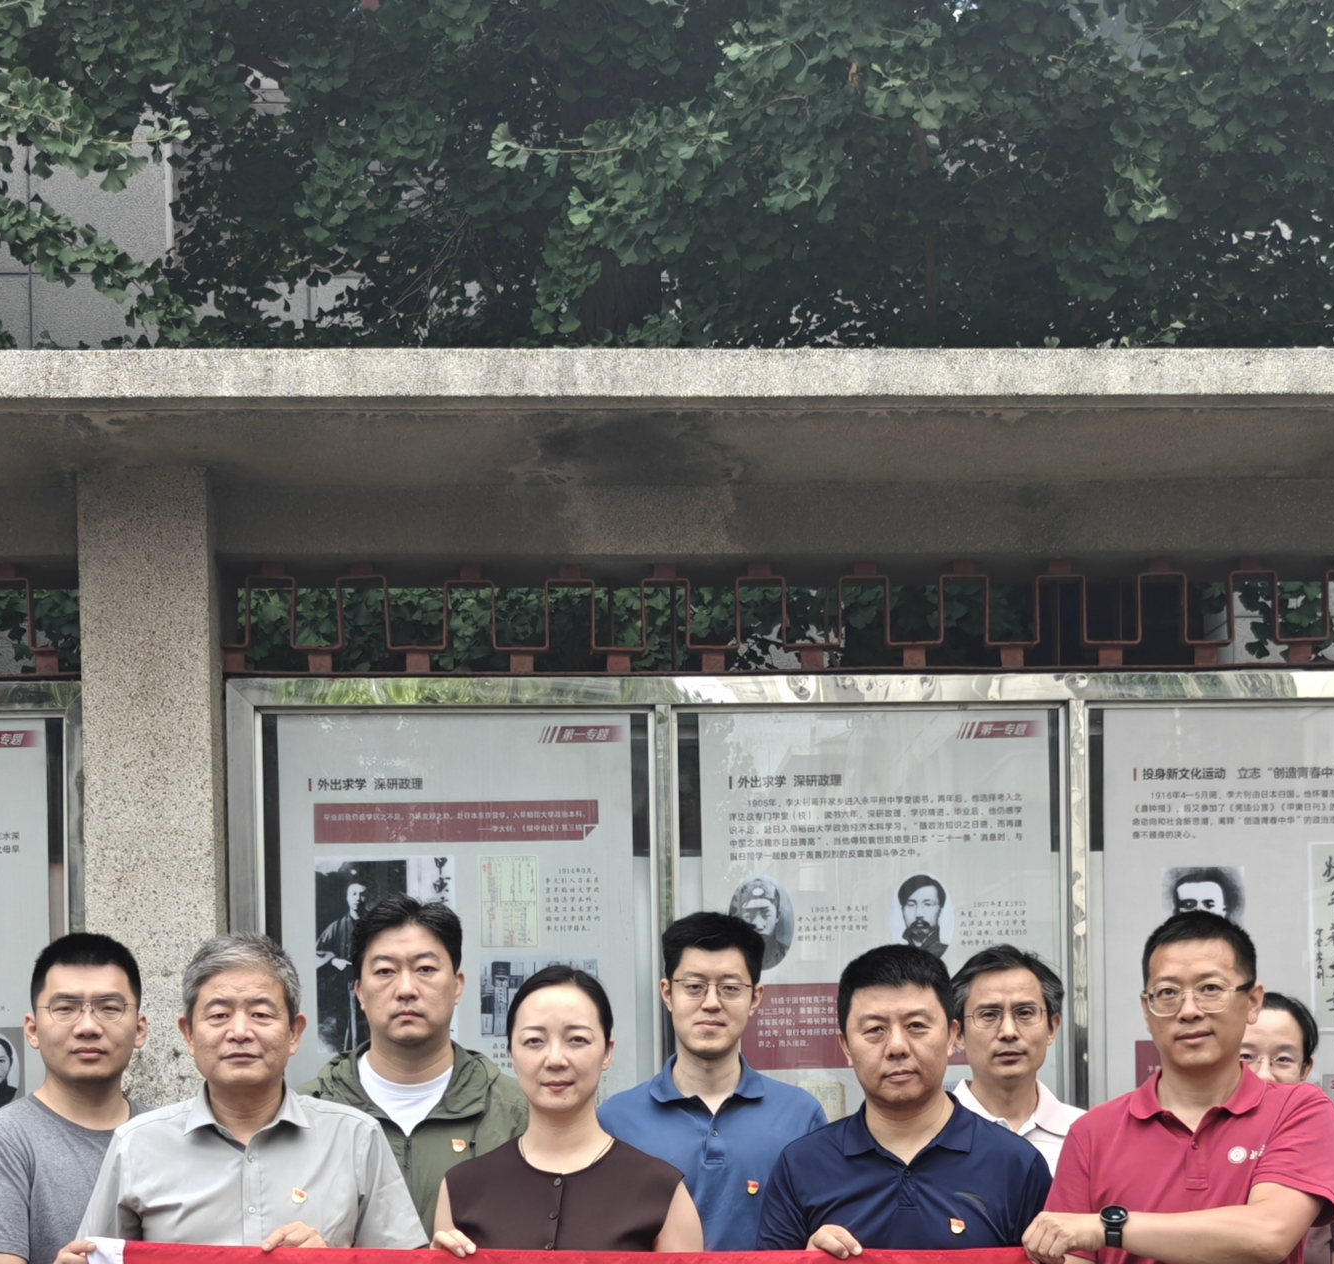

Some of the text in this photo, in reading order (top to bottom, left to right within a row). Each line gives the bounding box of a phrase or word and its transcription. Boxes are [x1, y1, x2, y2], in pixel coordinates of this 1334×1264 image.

[560, 727, 610, 741] 第一专题
[977, 722, 1028, 737] 第一专题
[1142, 767, 1226, 780] 投身新文化运动
[317, 778, 423, 791] 外出求学 深研政理
[737, 774, 842, 788] 外出求学 深研政理
